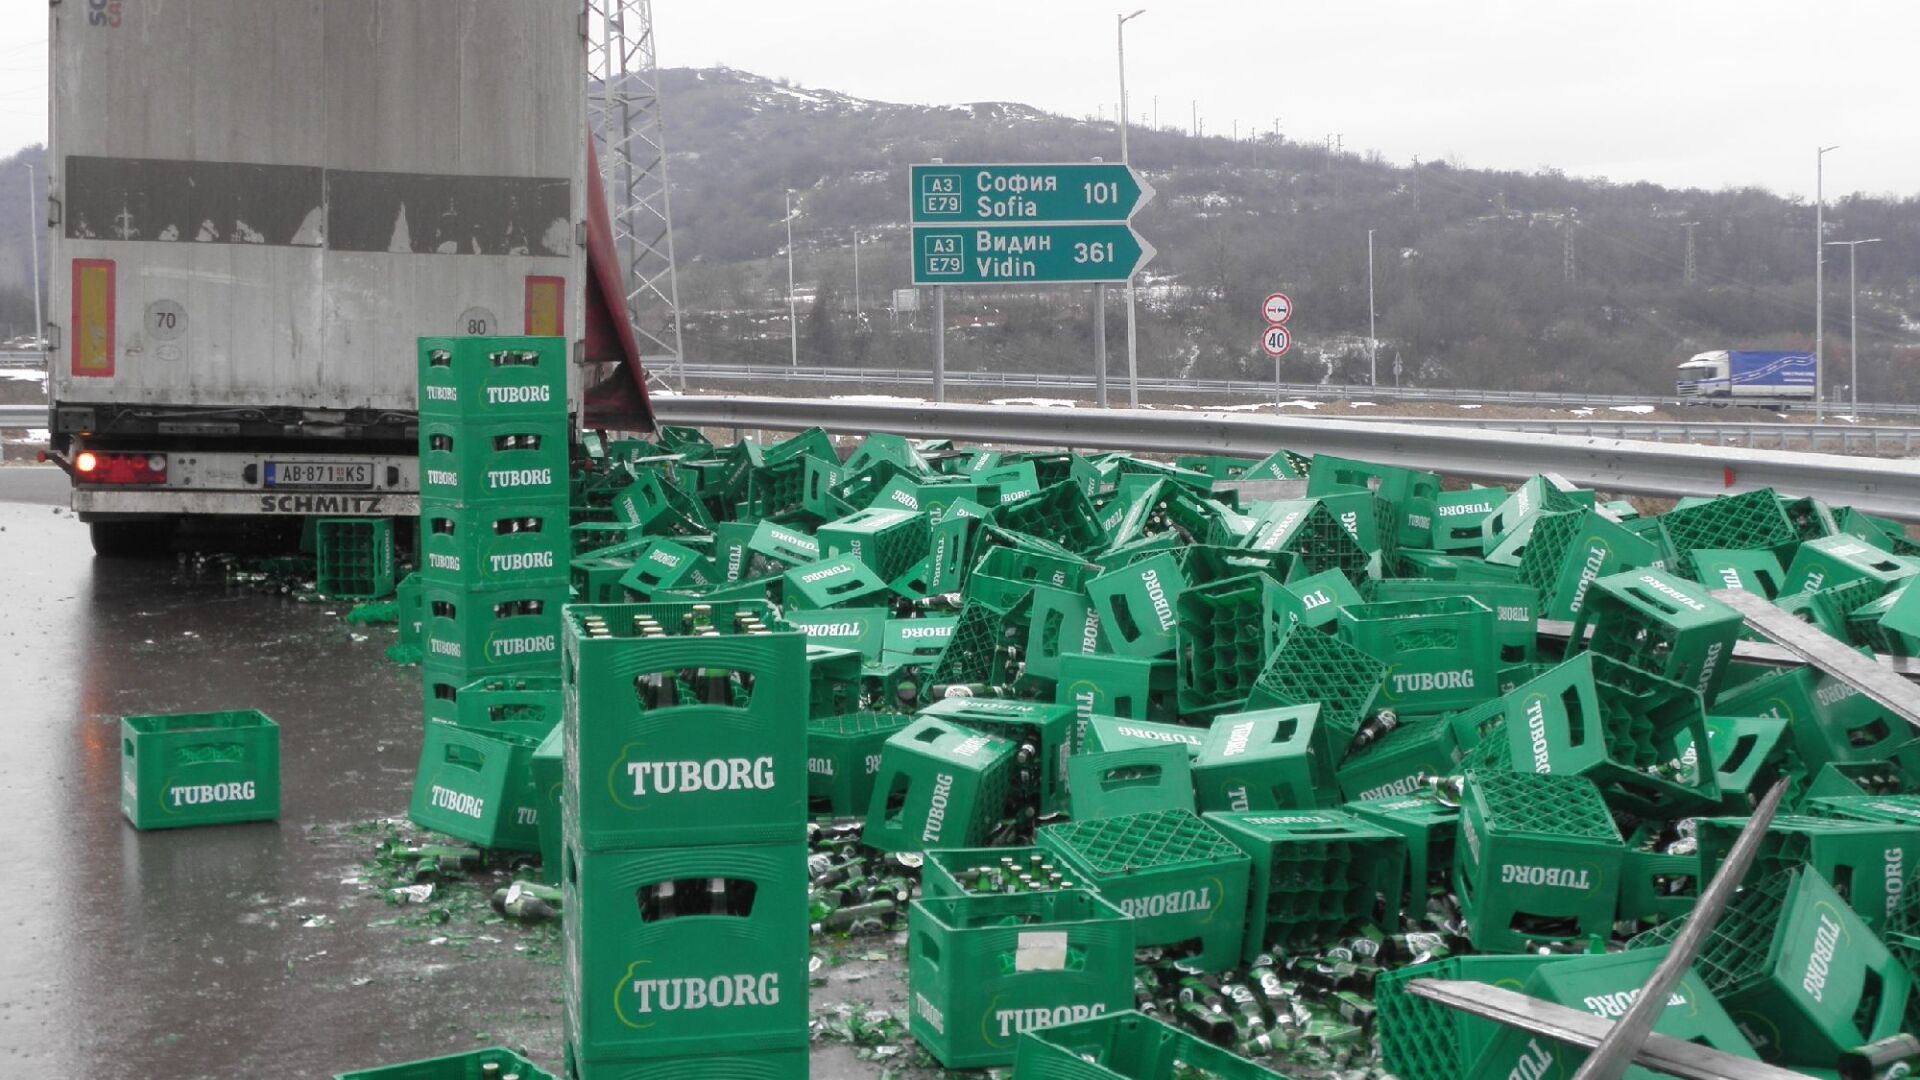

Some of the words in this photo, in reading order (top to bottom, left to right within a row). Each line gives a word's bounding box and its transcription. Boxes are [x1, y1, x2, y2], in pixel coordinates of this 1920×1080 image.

[932, 178, 953, 192] A3
[977, 171, 1058, 194] София
[1083, 182, 1118, 204] 101
[928, 197, 958, 211] E79
[977, 196, 1037, 217] Sofia
[934, 239, 955, 253] A3
[977, 231, 1051, 254] Видин
[1074, 243, 1114, 263] 361
[930, 257, 960, 272] E79
[977, 257, 1036, 277] Vidin
[156, 313, 177, 329] 70
[468, 319, 487, 336] 80
[1268, 333, 1285, 348] 40
[427, 385, 456, 401] TUBORG
[487, 385, 550, 403] TUBORG
[346, 466, 365, 482] KS
[428, 470, 457, 486] TUBORG
[488, 468, 552, 488] TUBORG
[261, 496, 382, 513] SCHMITZ
[1439, 501, 1493, 517] TUBORG
[429, 553, 460, 571] TUBORG
[491, 551, 553, 572] TUBORG
[933, 537, 945, 588] TUBORG
[801, 564, 852, 583] TUBORG
[1141, 569, 1176, 631] TUBORG
[1639, 575, 1705, 611] TUBORG
[431, 639, 461, 657] TUBORG
[493, 635, 555, 657] TUBORG
[1393, 669, 1475, 693] TUBORG
[1118, 725, 1202, 746] TUBORG
[628, 756, 775, 796] TUBORG
[171, 781, 255, 806] TUBORG
[432, 785, 484, 819] TUBORG
[922, 773, 954, 842] TUBORG
[1502, 864, 1590, 889] TUBORG
[1121, 887, 1211, 918] TUBORG
[1803, 913, 1841, 1003] TUBORG
[634, 972, 780, 1013] TUBORG
